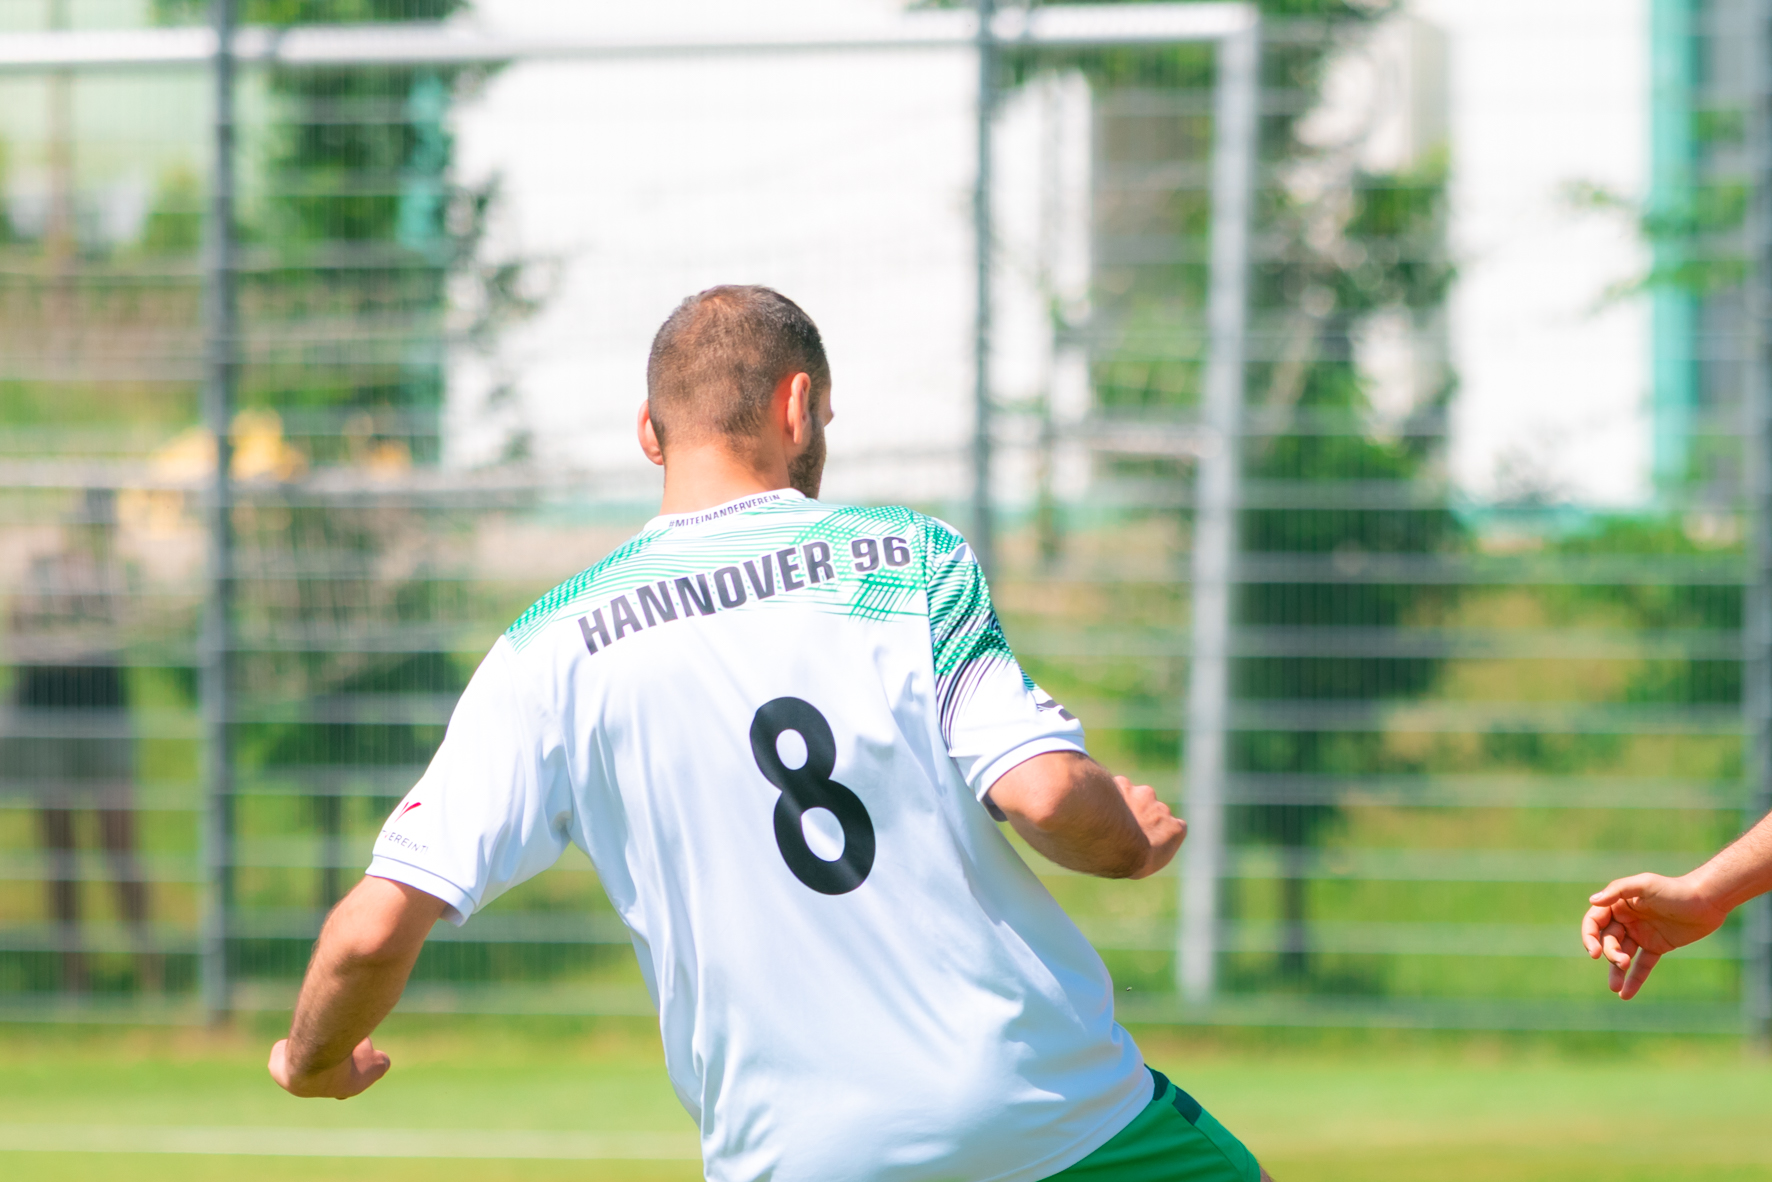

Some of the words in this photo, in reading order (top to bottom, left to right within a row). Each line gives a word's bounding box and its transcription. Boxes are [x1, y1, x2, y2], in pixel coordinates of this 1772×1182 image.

[669, 494, 781, 528] #MITEINANDERVEREIN
[577, 541, 836, 656] HANNOVER
[851, 536, 912, 573] 96
[749, 696, 876, 896] 8
